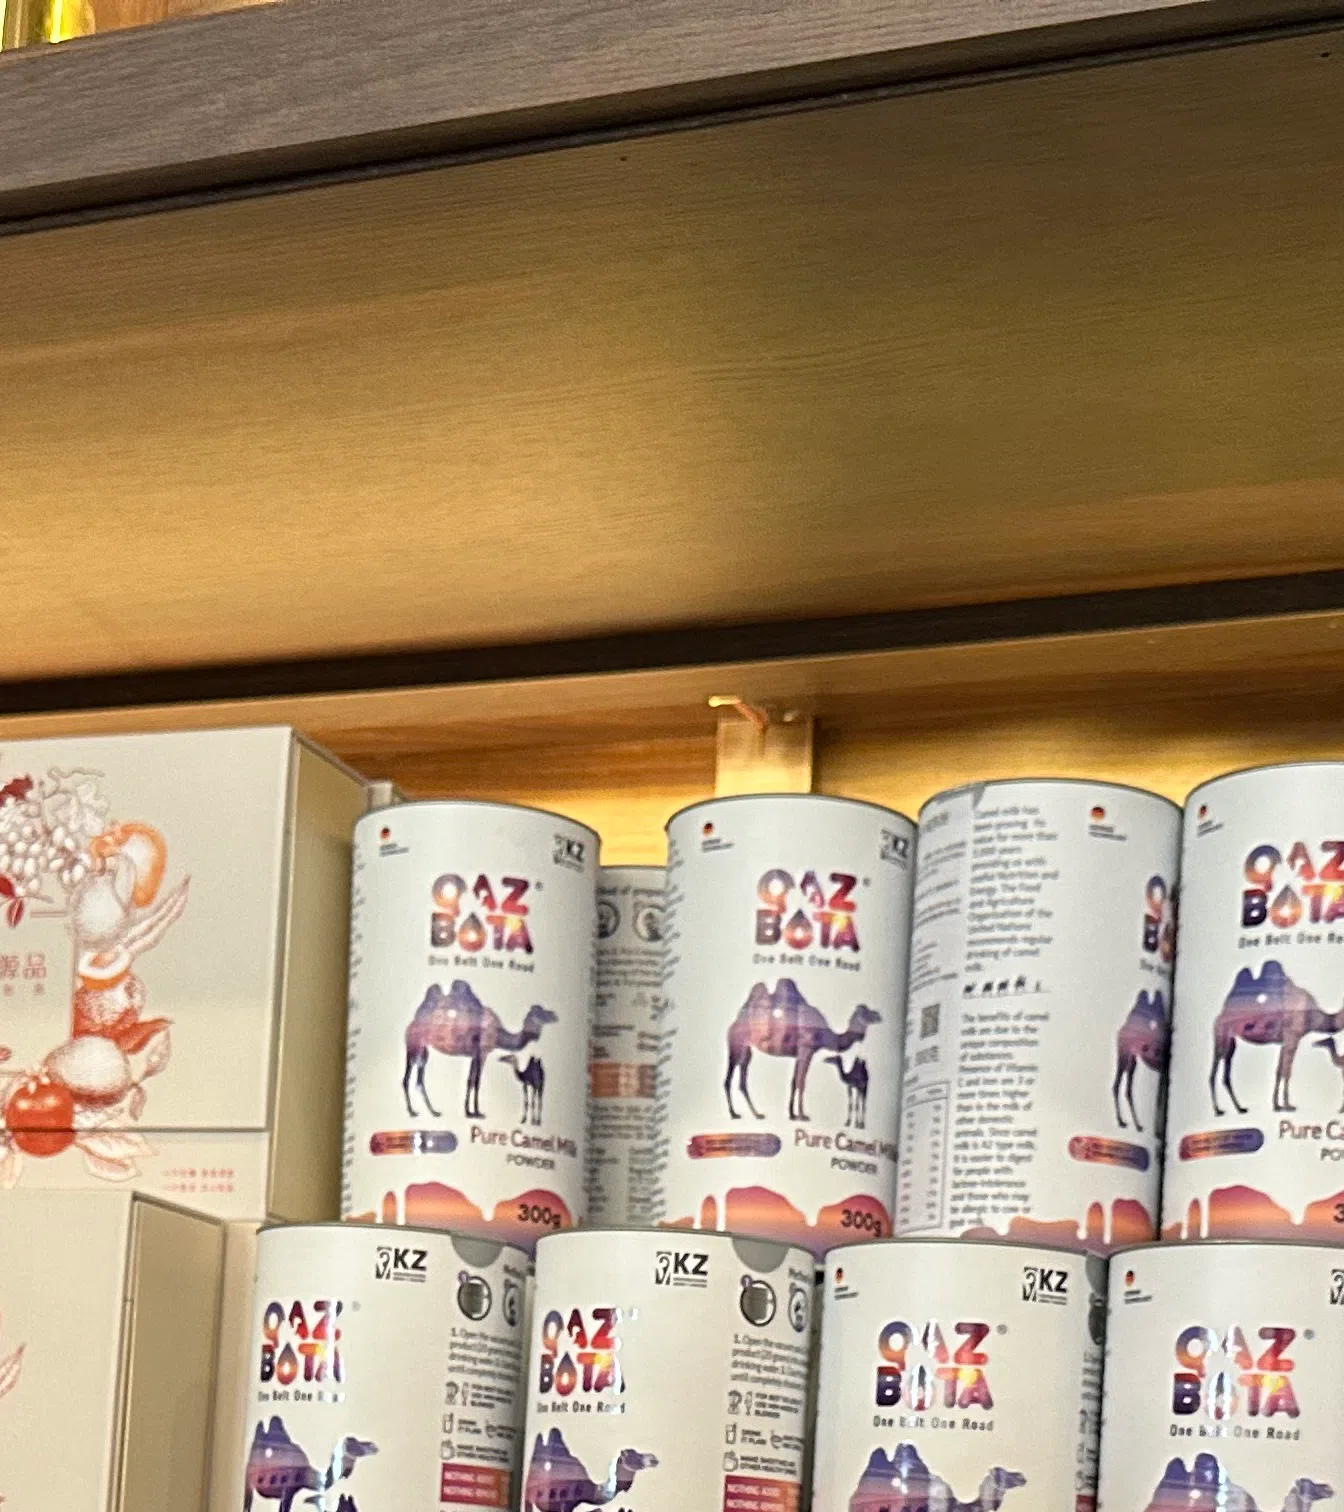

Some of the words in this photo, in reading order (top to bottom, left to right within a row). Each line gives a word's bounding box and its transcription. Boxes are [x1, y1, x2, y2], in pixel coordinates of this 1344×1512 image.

[471, 1126, 507, 1145] Pure
[795, 1128, 831, 1150] Pure
[1279, 1120, 1321, 1140] Pure
[841, 1209, 881, 1237] 300g
[394, 1250, 428, 1271] KZ
[674, 1253, 708, 1275] KZ
[1040, 1270, 1069, 1293] KZ
[294, 1391, 312, 1401] One
[573, 1403, 591, 1412] One
[874, 1416, 893, 1428] One
[962, 1418, 993, 1431] Road
[1170, 1425, 1192, 1437] One
[1267, 1428, 1300, 1440] Road
